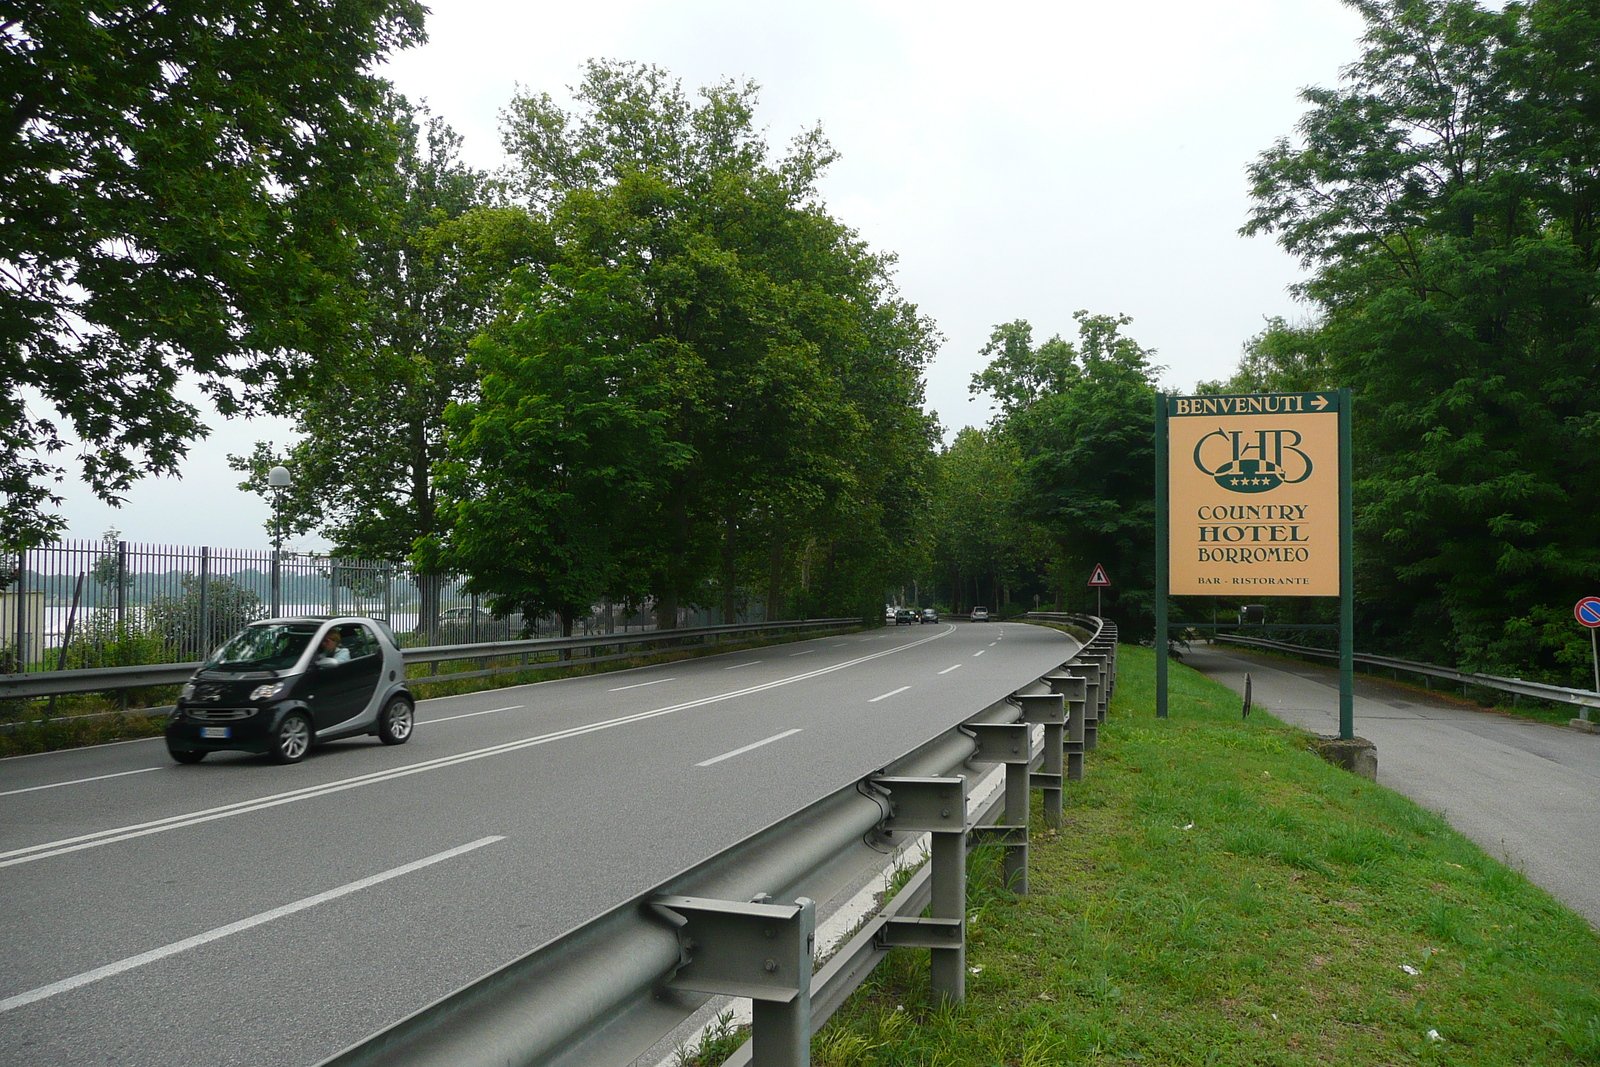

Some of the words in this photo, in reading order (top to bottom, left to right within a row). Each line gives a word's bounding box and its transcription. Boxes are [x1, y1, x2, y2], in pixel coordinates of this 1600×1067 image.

[1176, 395, 1304, 415] BENVENUTI
[1197, 504, 1309, 521] COUNTRY
[1198, 525, 1310, 542] HOTEL
[1197, 547, 1309, 564] BORROMEO
[1198, 577, 1221, 585] BAR
[1232, 577, 1310, 585] RISTORANTE
